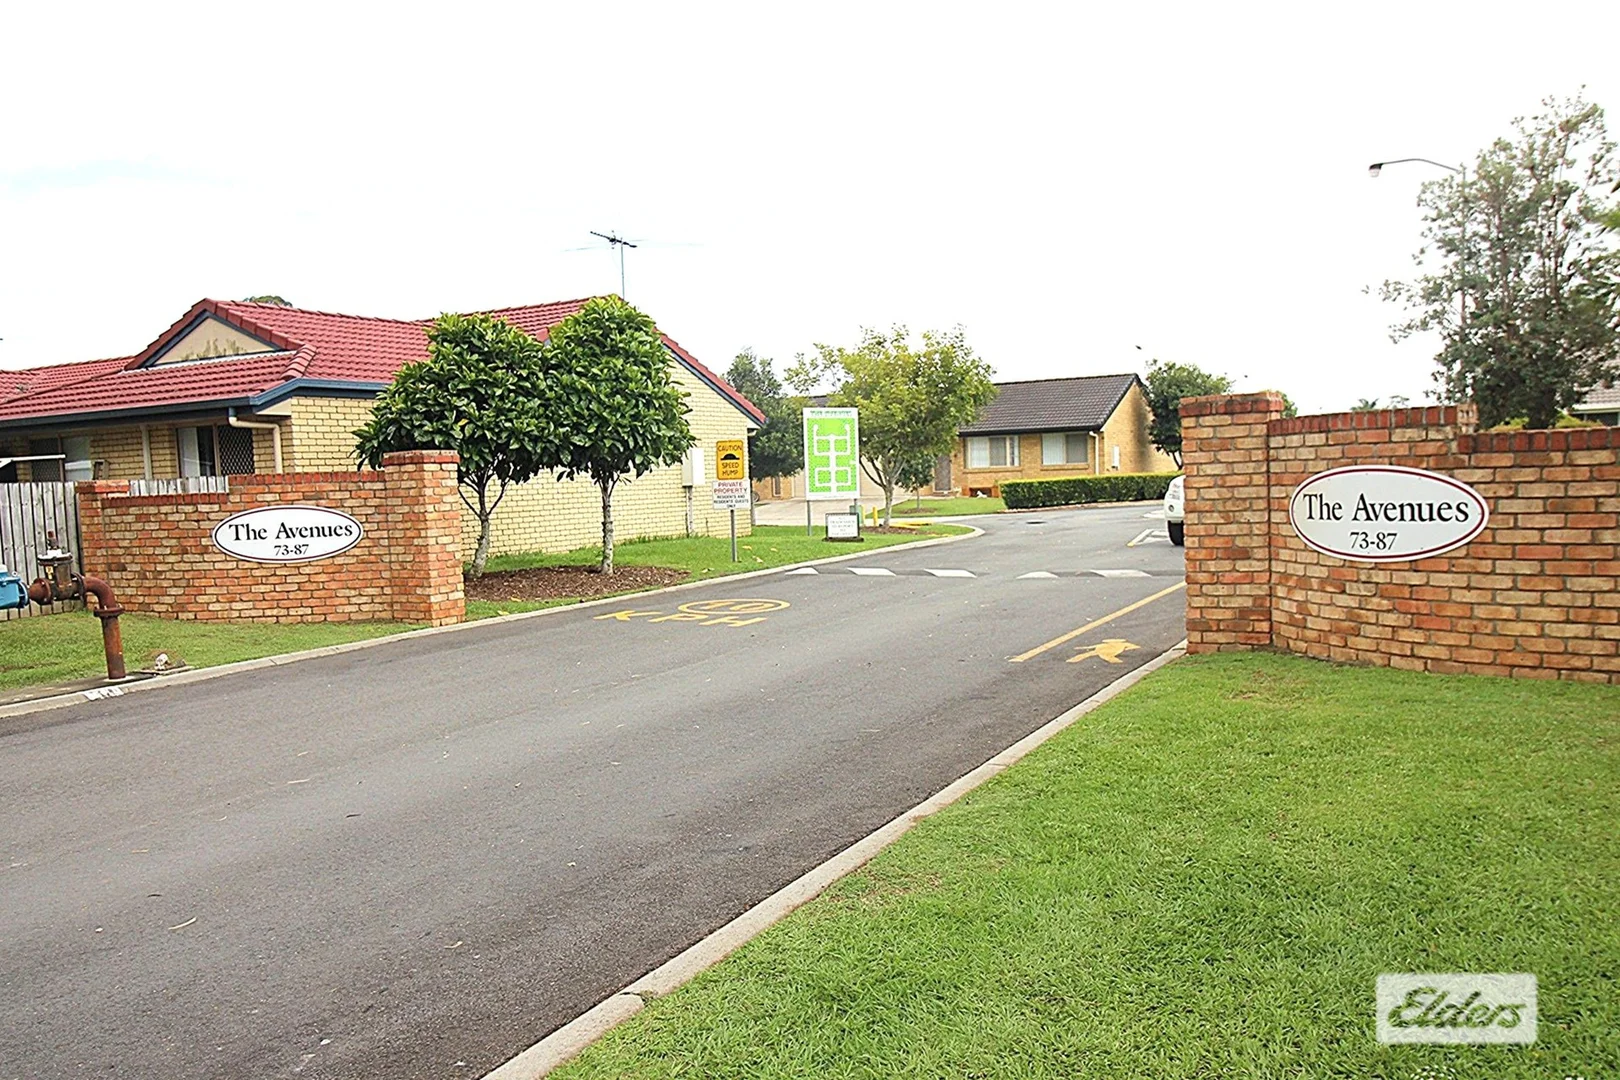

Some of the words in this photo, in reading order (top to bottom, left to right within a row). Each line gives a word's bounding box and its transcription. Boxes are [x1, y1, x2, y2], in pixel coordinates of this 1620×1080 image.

[1303, 492, 1343, 521] The
[1351, 492, 1470, 523] Avenues
[228, 522, 268, 541] The
[275, 521, 353, 540] Avenues
[1350, 531, 1397, 551] 73-87
[273, 543, 309, 556] 73-87
[593, 609, 768, 627] KPH
